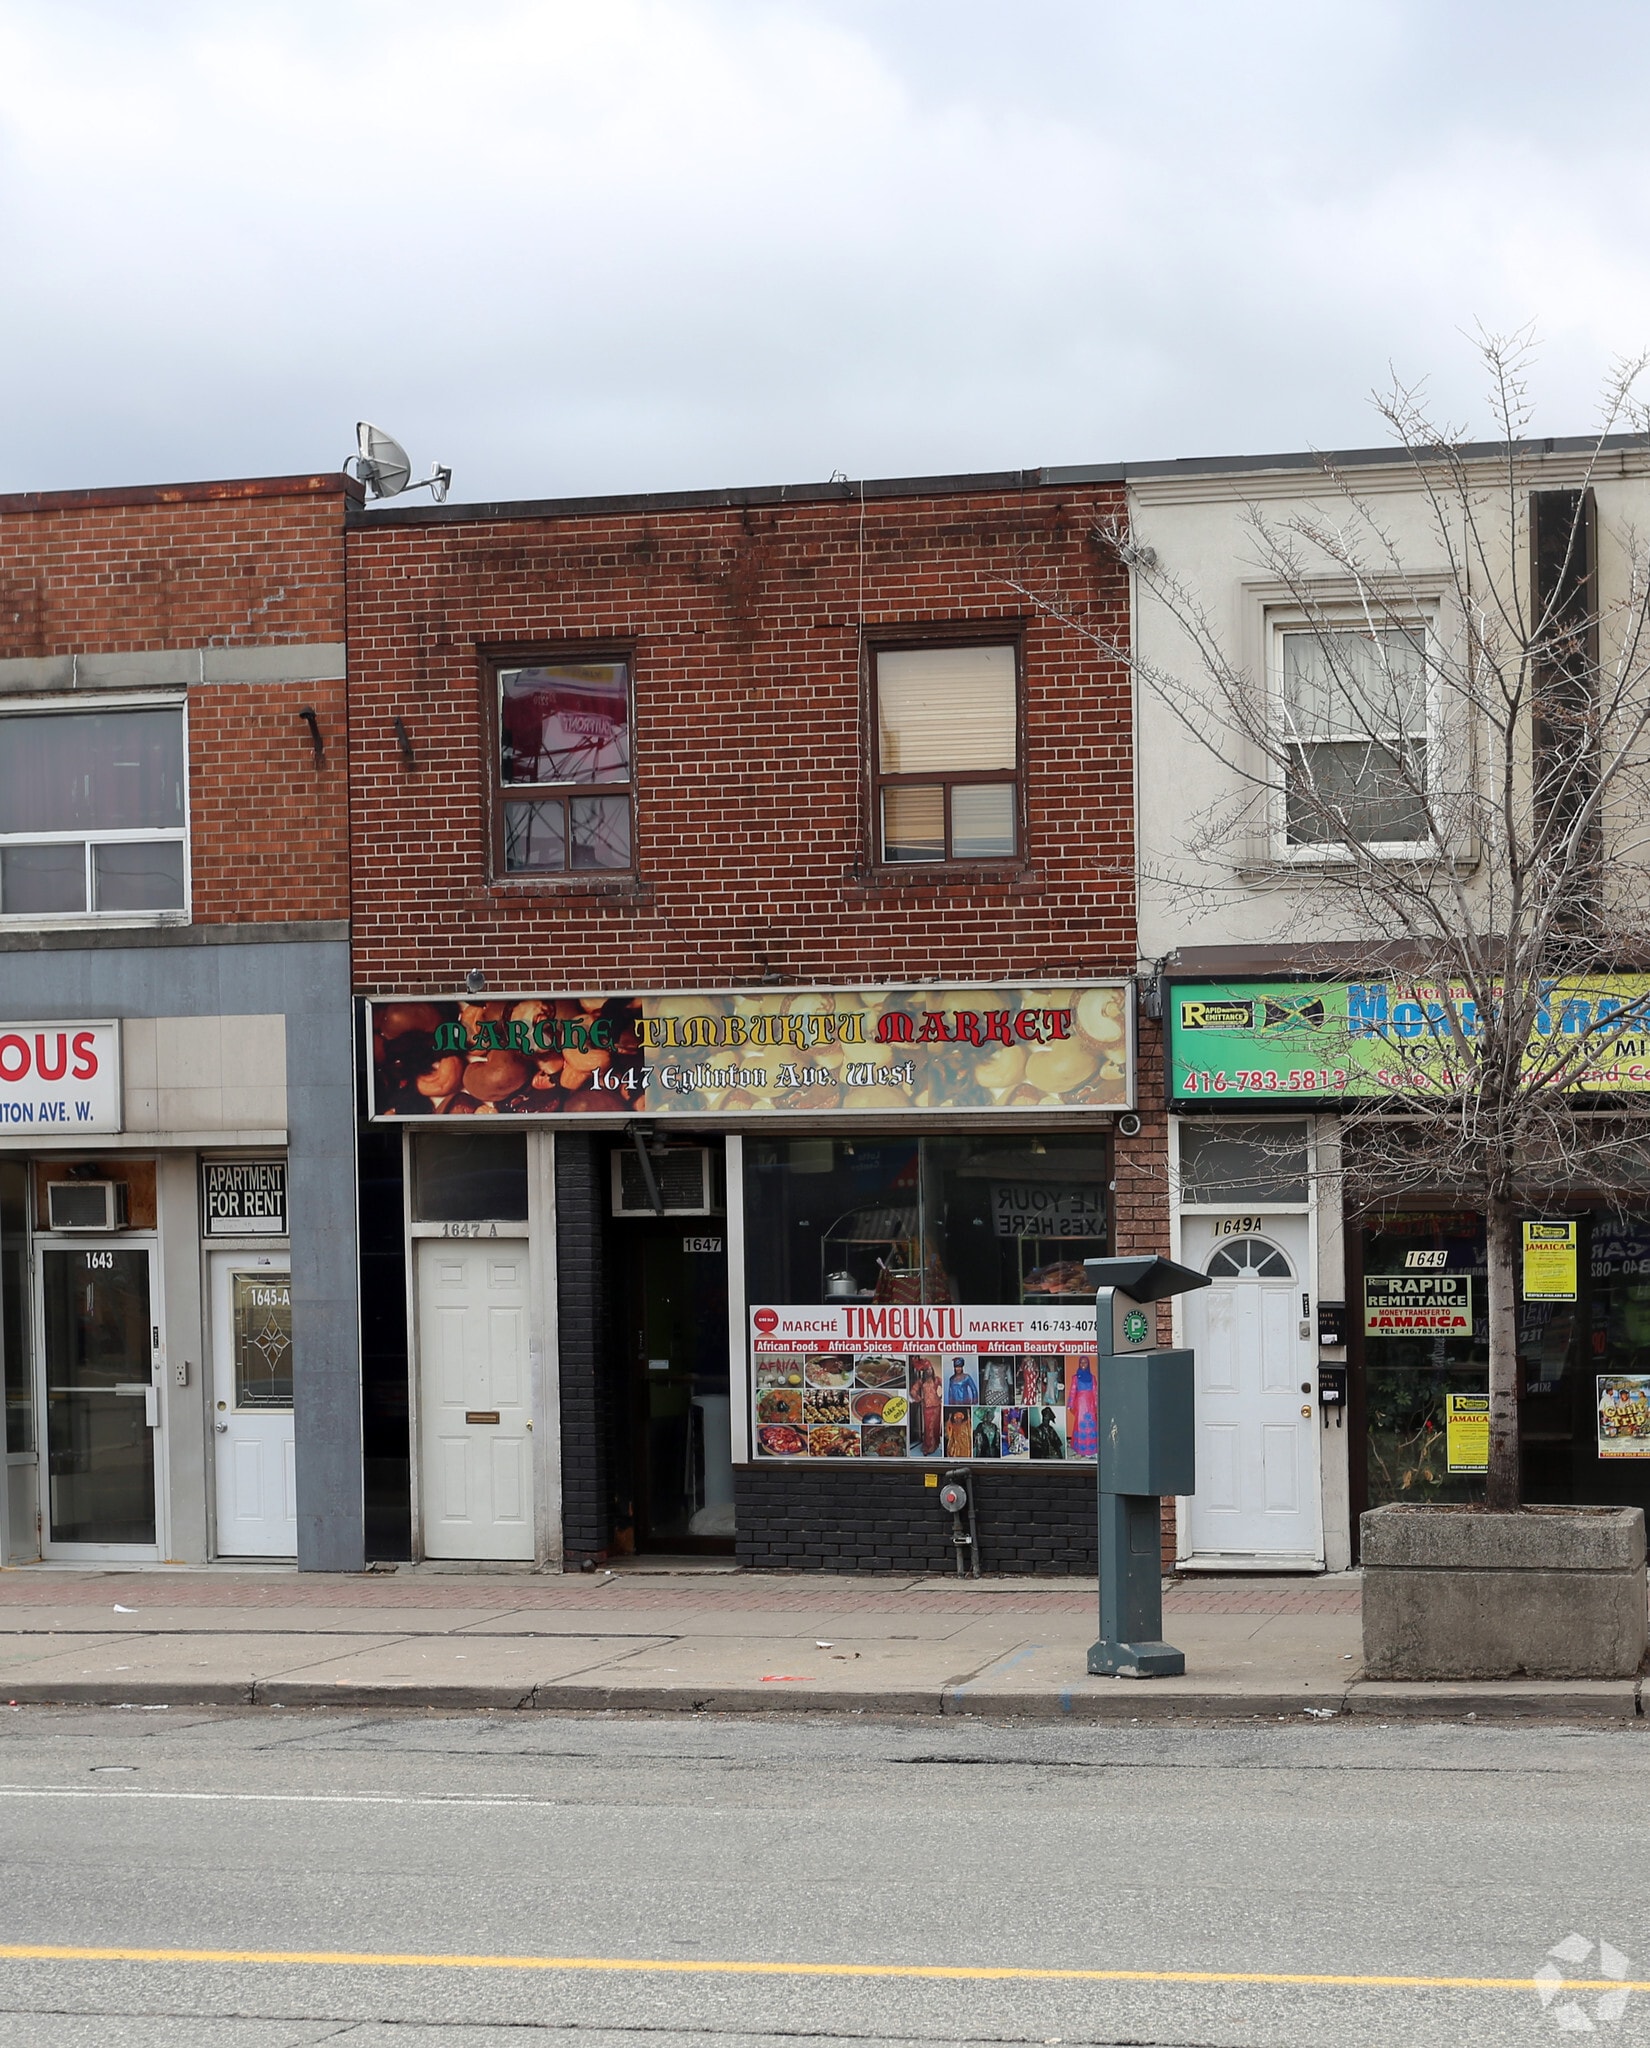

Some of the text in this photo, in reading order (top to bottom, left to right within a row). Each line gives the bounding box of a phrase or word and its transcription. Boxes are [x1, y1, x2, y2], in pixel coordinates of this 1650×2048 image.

[634, 1014, 866, 1050] TIMBUKTU
[875, 1009, 1071, 1047] MARKET
[0, 1032, 99, 1082] OUS
[590, 1060, 916, 1094] 1647 Eglinton Ave. West
[1183, 1070, 1346, 1093] 416-783-5813
[0, 1101, 93, 1122] TON AVE. W.
[209, 1165, 282, 1191] APARTMENT
[209, 1191, 283, 1216] FOR RENT
[441, 1223, 498, 1238] 1647 A
[1215, 1217, 1262, 1236] 1649A
[685, 1238, 721, 1251] 1647
[1525, 1243, 1566, 1251] JAMAICA
[86, 1253, 113, 1269] 1643
[1409, 1252, 1445, 1266] 1649
[1388, 1279, 1457, 1293] RAPID
[251, 1289, 291, 1306] 1645-A
[1368, 1295, 1466, 1306] REMITTANCE
[1379, 1308, 1403, 1316] MONEY
[1405, 1308, 1440, 1316] TRANSFER
[782, 1318, 838, 1332] MARCHÉ
[841, 1307, 963, 1338] TIMBUKTU
[969, 1321, 1025, 1333] MARKET
[1368, 1316, 1467, 1328] JAMAICA
[757, 1341, 789, 1352] African
[791, 1341, 818, 1352] Foods
[828, 1341, 860, 1352] African
[863, 1341, 892, 1354] Spices
[902, 1341, 935, 1352] African
[938, 1341, 978, 1354] Clothing
[988, 1341, 1022, 1352] African
[1024, 1341, 1058, 1354] Beauty
[1604, 1403, 1645, 1417] Guilt
[1448, 1415, 1488, 1424] JAMAICA
[1611, 1414, 1645, 1428] Trip
